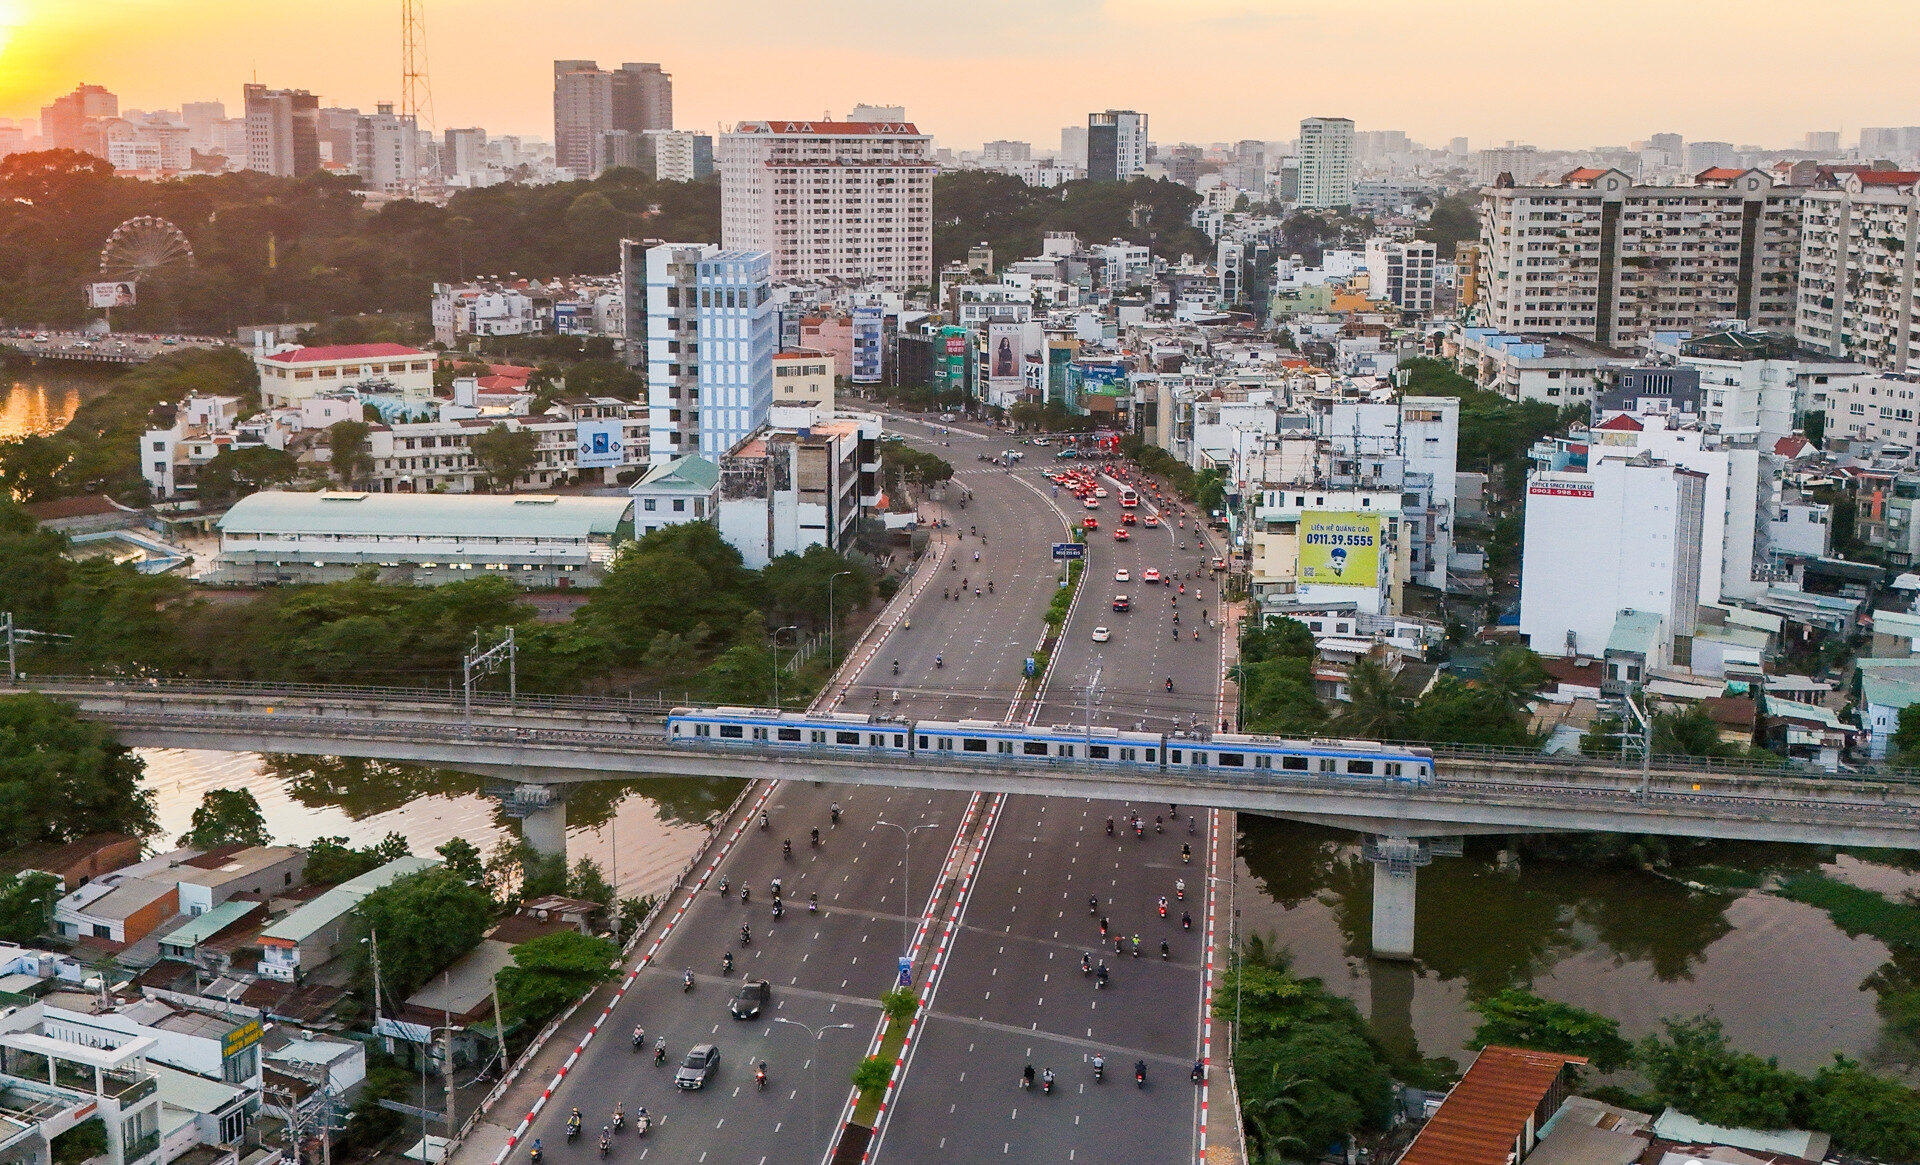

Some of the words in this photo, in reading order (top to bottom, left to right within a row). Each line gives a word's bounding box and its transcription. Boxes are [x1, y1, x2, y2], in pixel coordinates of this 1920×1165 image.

[1607, 178, 1619, 191] D
[1748, 177, 1760, 191] D
[1311, 523, 1324, 531] LIÊN
[1306, 533, 1373, 546] 0911.39.5555
